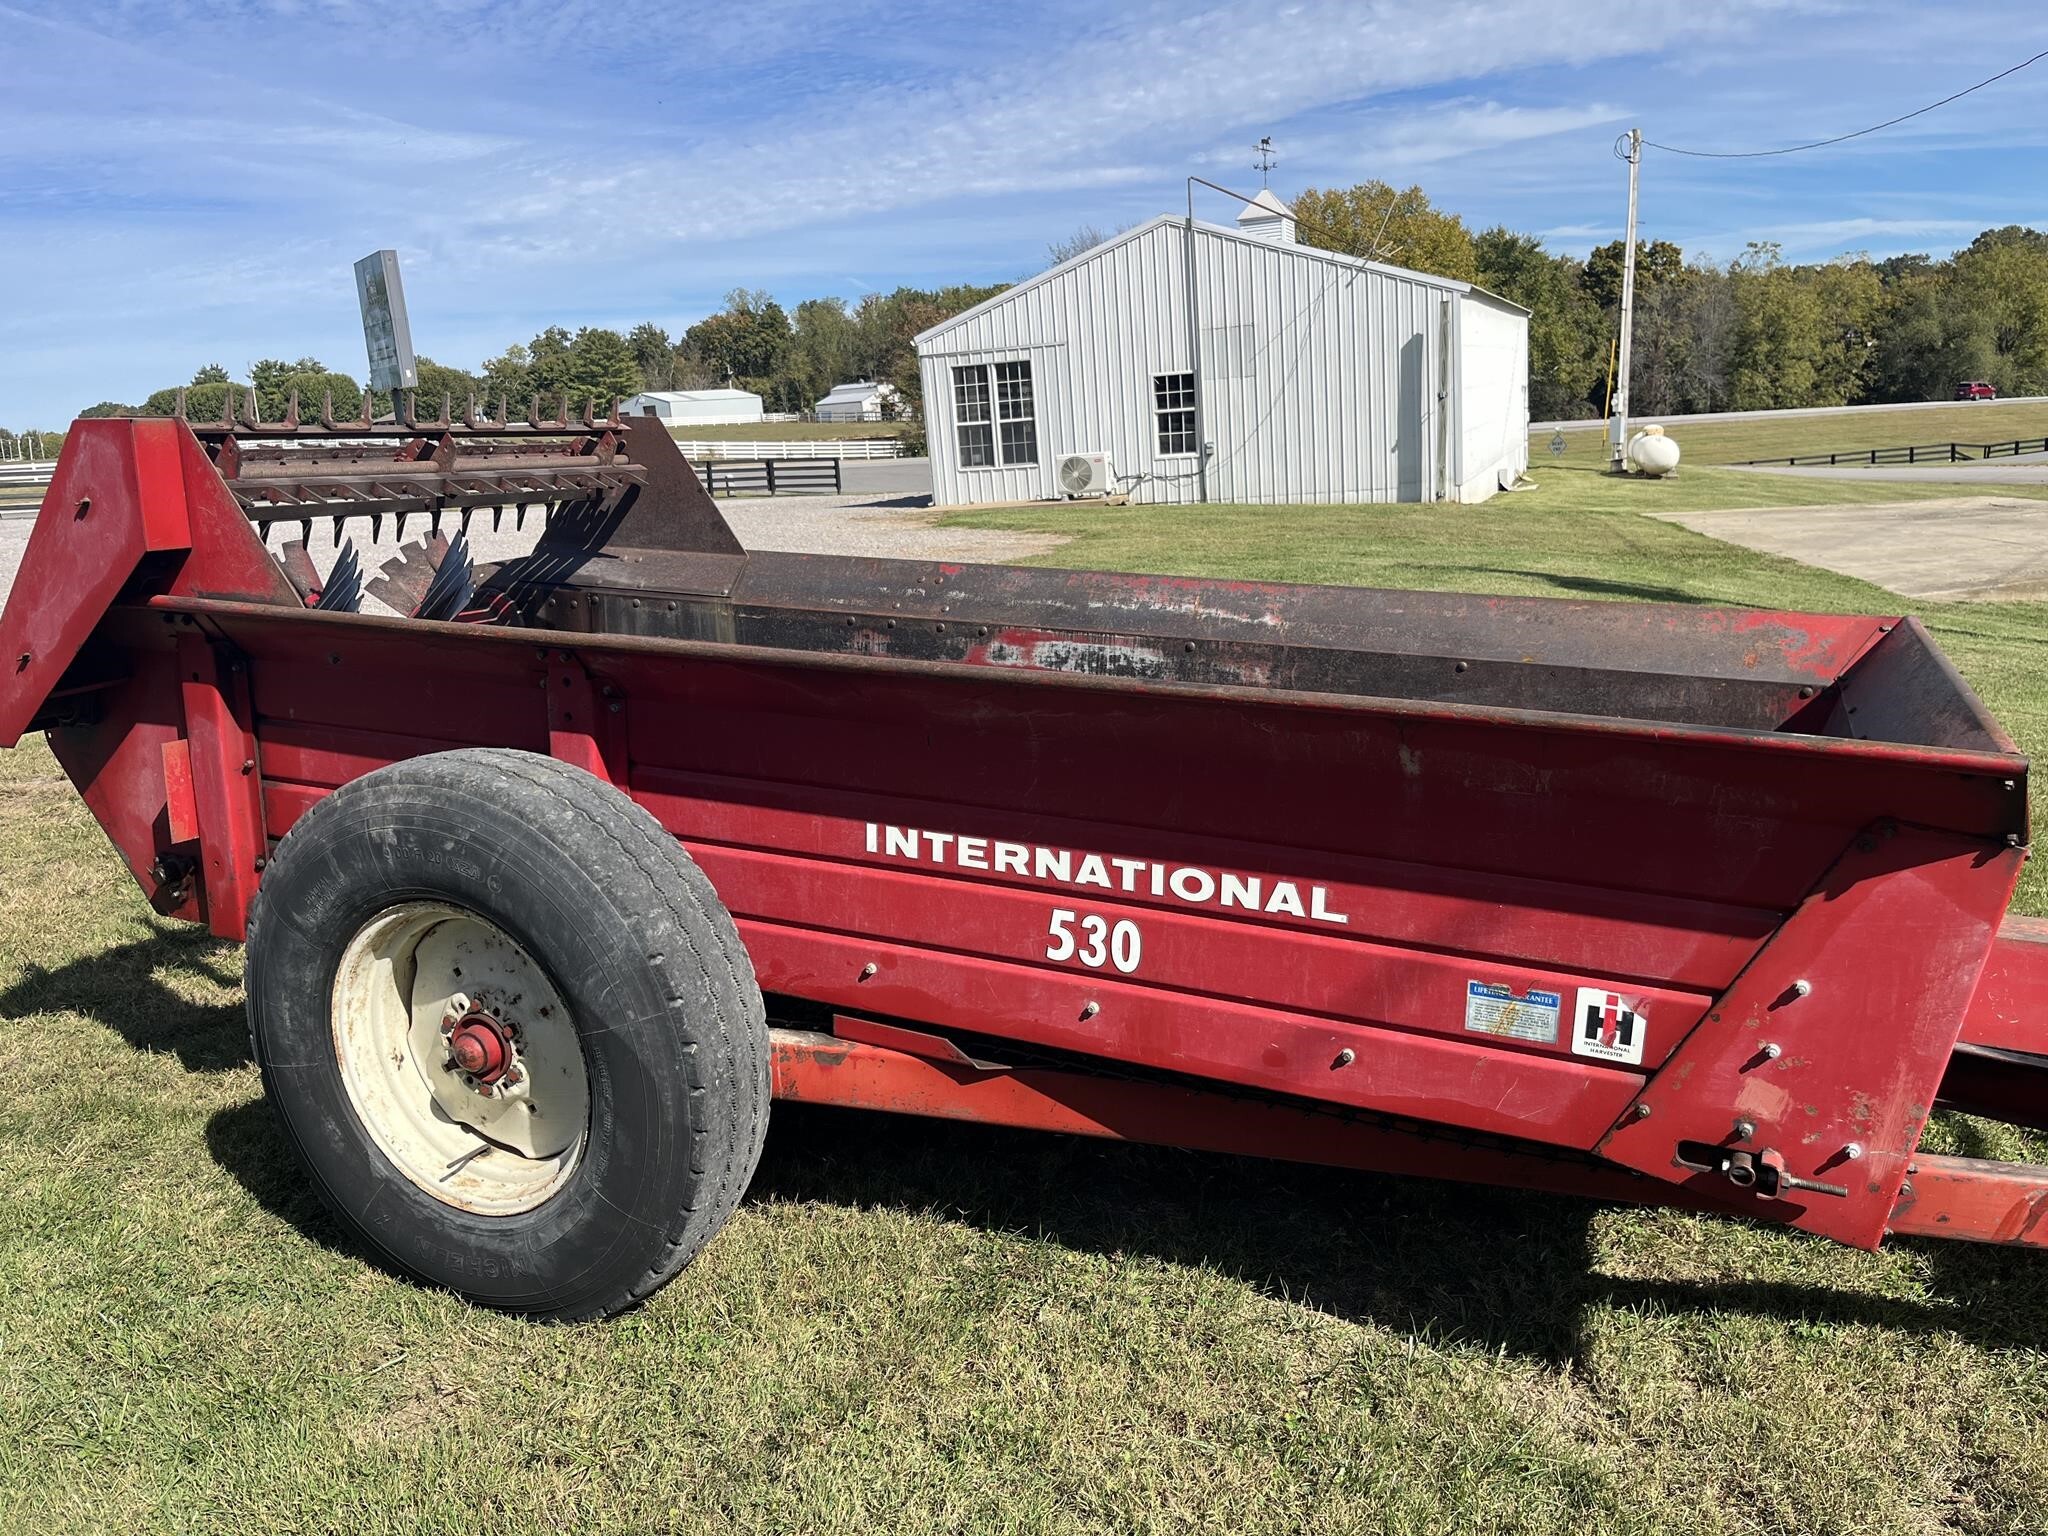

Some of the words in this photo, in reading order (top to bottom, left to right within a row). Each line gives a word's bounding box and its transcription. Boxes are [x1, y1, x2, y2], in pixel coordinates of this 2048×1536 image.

[865, 821, 1349, 924] INTERNATIONAL
[1045, 907, 1144, 975] 530
[1589, 1047, 1623, 1058] HARVESTER
